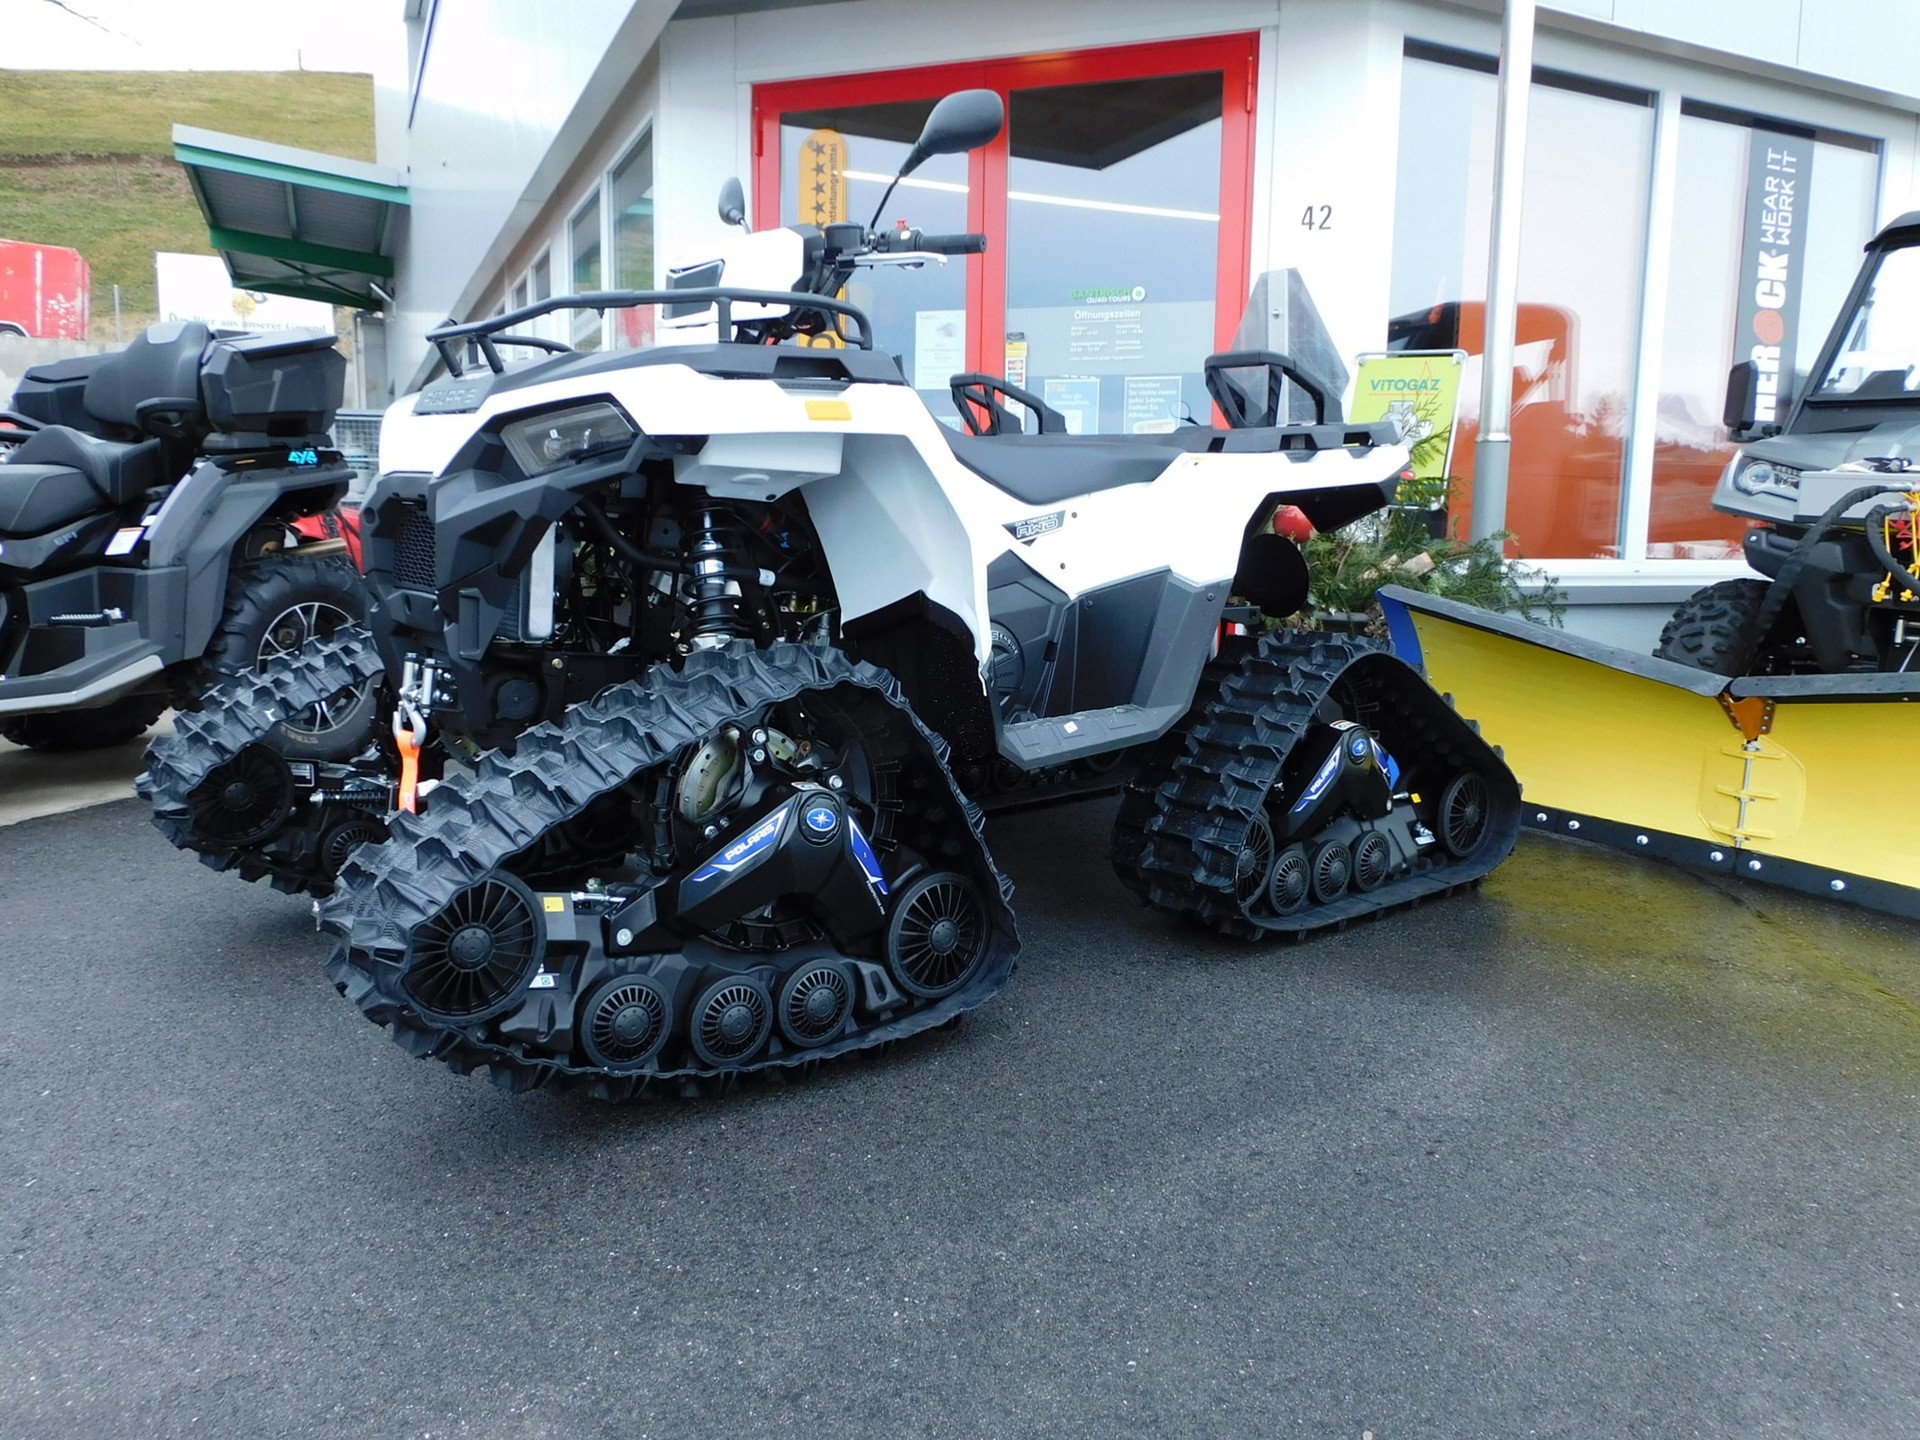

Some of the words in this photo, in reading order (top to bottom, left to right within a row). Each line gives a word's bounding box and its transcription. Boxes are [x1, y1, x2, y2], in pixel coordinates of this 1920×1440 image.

[1766, 147, 1782, 170] IT
[1781, 150, 1798, 174] IT
[1300, 204, 1333, 231] 42
[1760, 175, 1781, 243] WEAR
[1775, 179, 1796, 246] WORK
[1074, 308, 1141, 320] Öffnungszeiten
[54, 531, 78, 546] EFI
[1016, 519, 1059, 538] AWD
[1310, 758, 1336, 793] POLARIS
[725, 824, 776, 861] POLARIS
